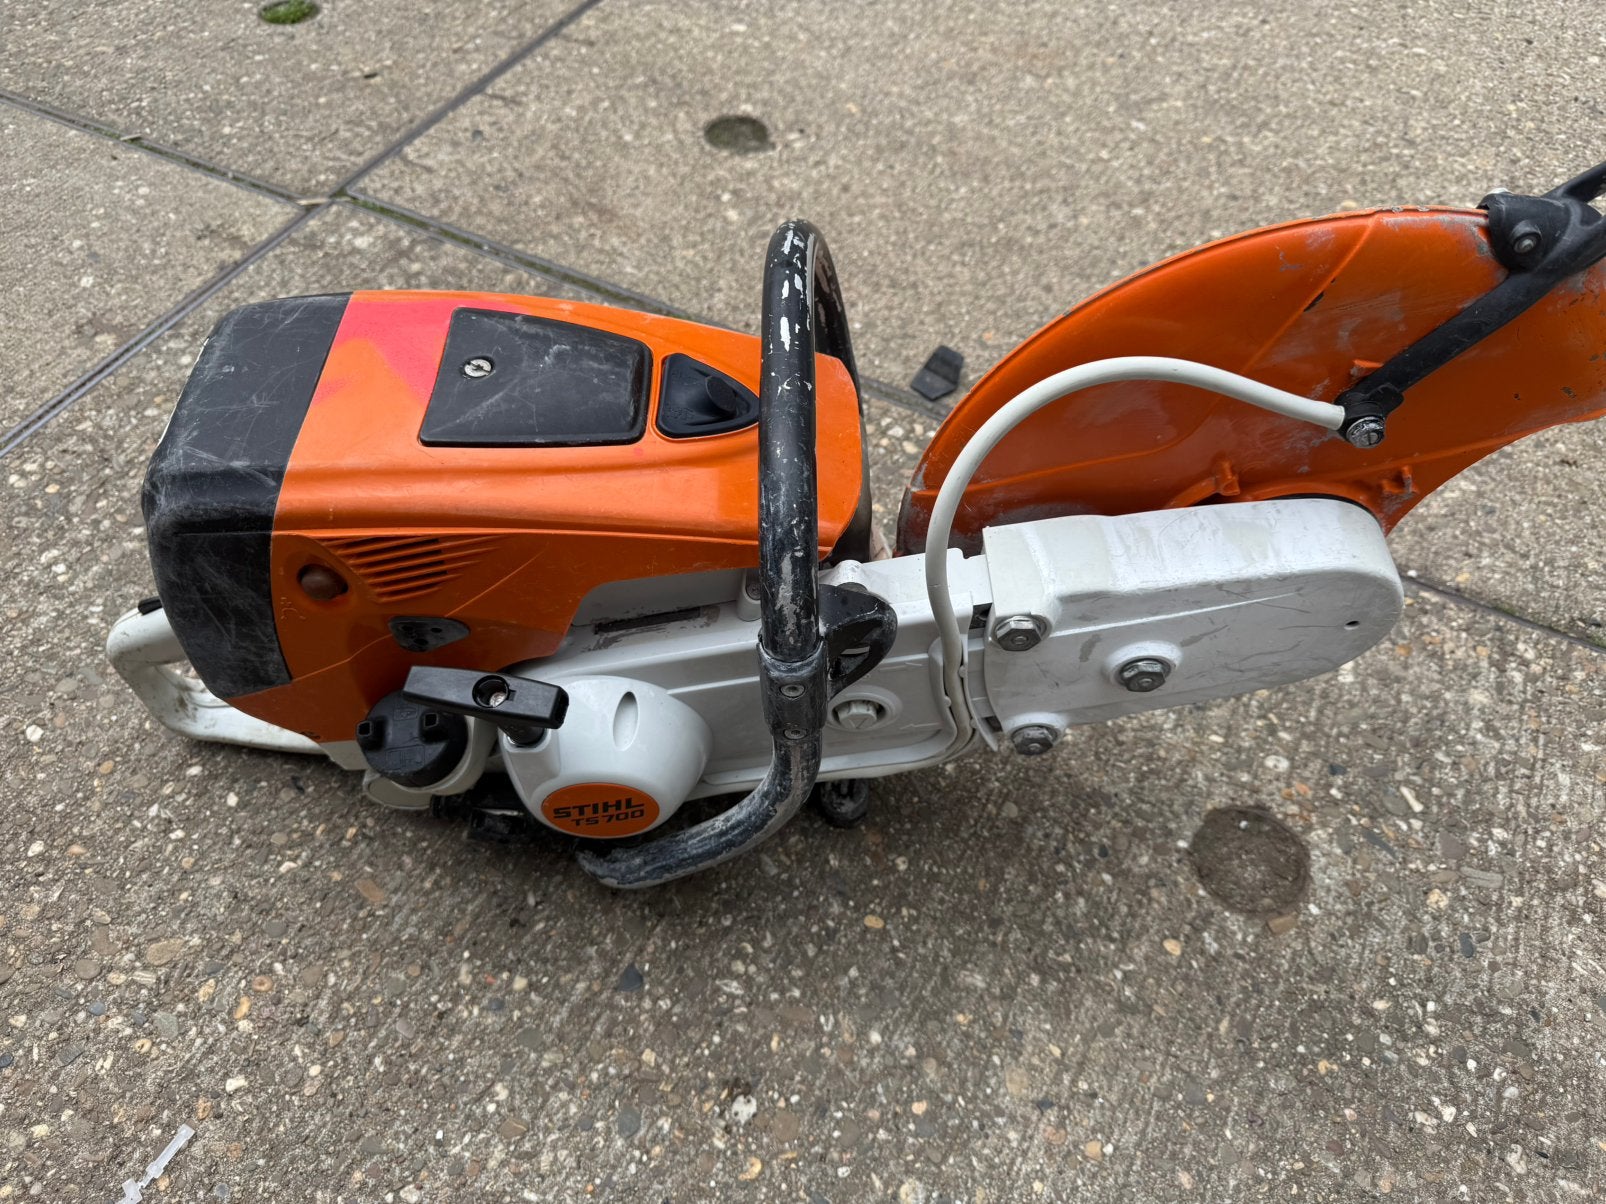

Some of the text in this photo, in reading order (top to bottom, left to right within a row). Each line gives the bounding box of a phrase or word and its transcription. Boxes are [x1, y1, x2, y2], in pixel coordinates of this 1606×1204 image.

[553, 797, 645, 819] STIHL
[571, 809, 645, 826] TS 700
